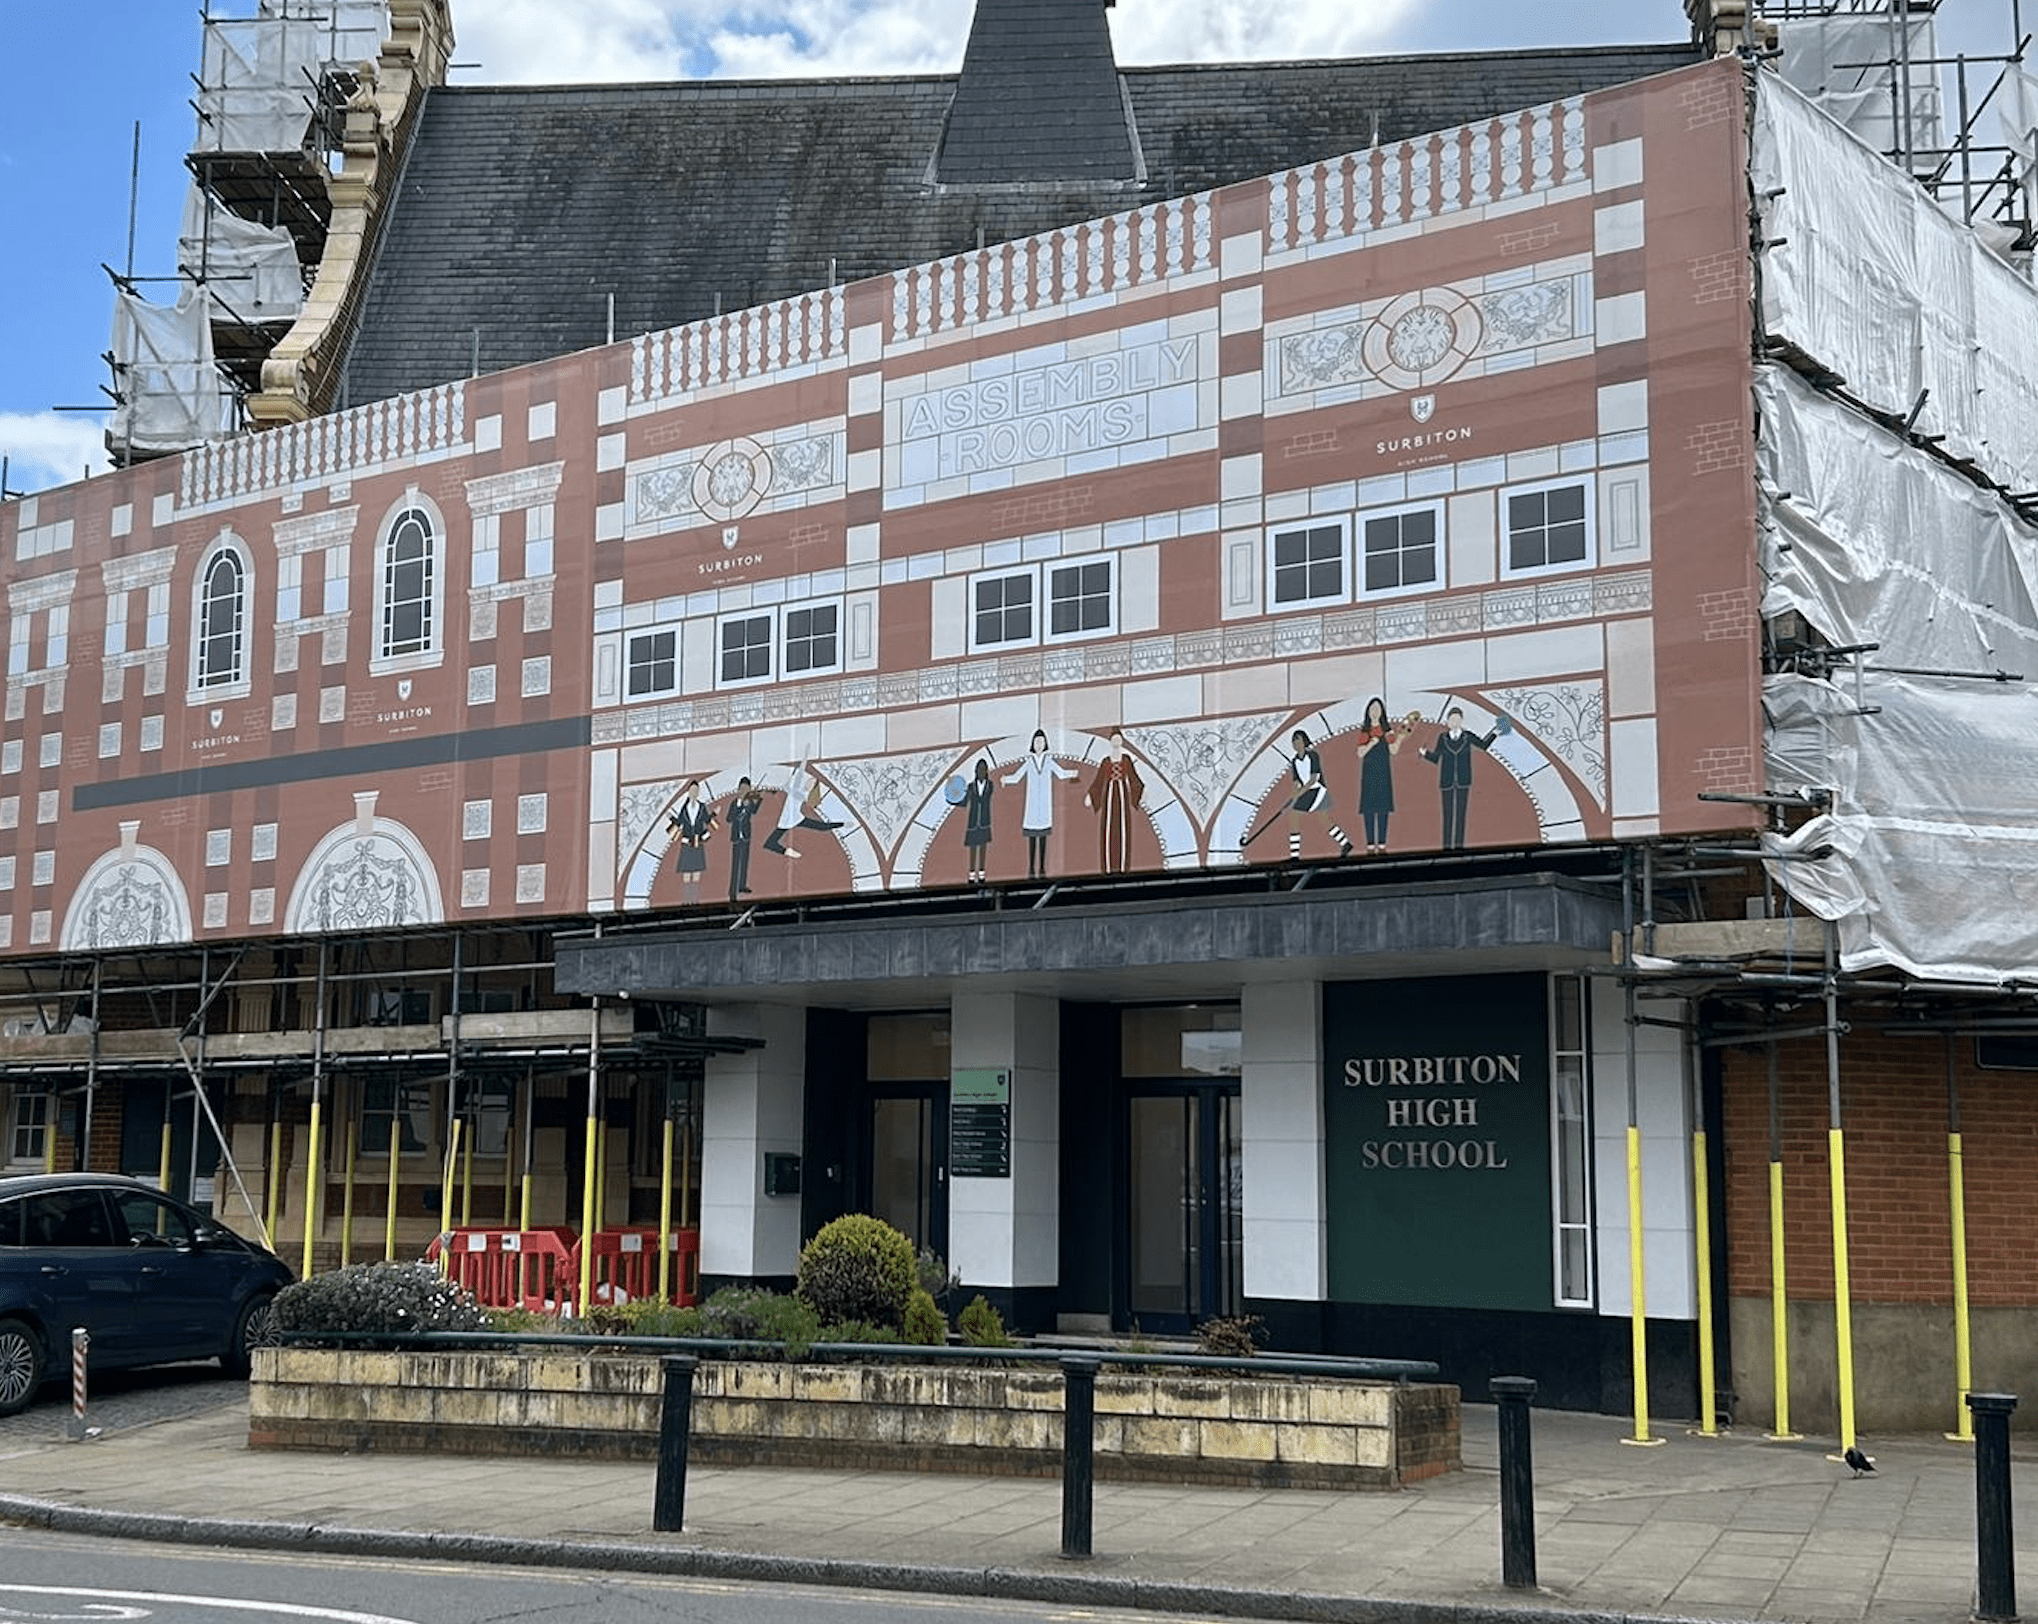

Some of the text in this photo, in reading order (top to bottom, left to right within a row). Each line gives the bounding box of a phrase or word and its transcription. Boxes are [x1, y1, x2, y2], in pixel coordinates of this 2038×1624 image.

[905, 340, 1194, 437] ASSEMBLY
[1376, 427, 1472, 455] SURBITON
[698, 554, 763, 574] SURBITON
[377, 707, 432, 722] SURBITON
[192, 735, 240, 750] SURBITON
[1344, 1055, 1522, 1087] SURBITON
[1386, 1098, 1479, 1127] HIGH
[1362, 1140, 1508, 1169] SCHOOL
